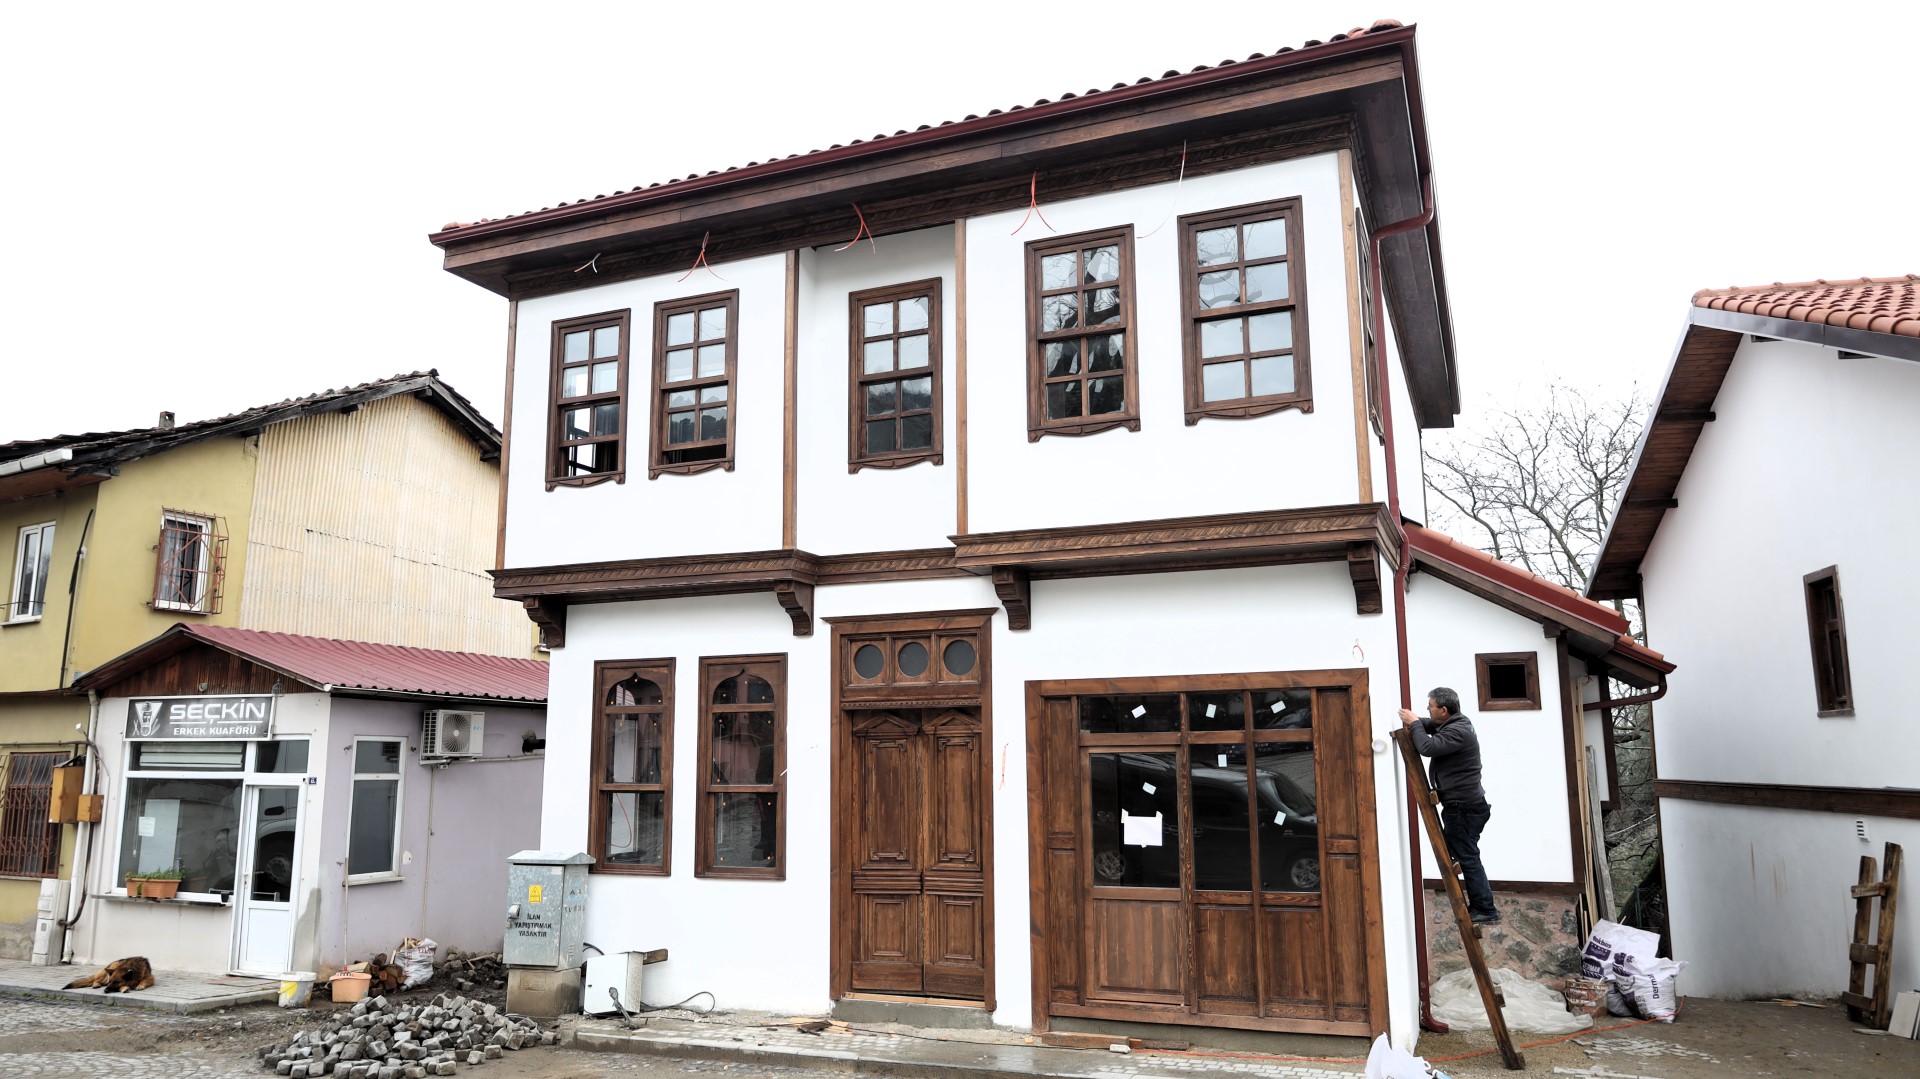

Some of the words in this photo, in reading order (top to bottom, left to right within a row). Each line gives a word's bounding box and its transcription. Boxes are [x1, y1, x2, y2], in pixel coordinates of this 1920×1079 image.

[169, 699, 266, 724] SEÇKİN
[173, 727, 206, 736] ERKEK
[209, 725, 257, 736] KUAFÖRÜ
[514, 921, 552, 930] YAPIŞTIRMAK
